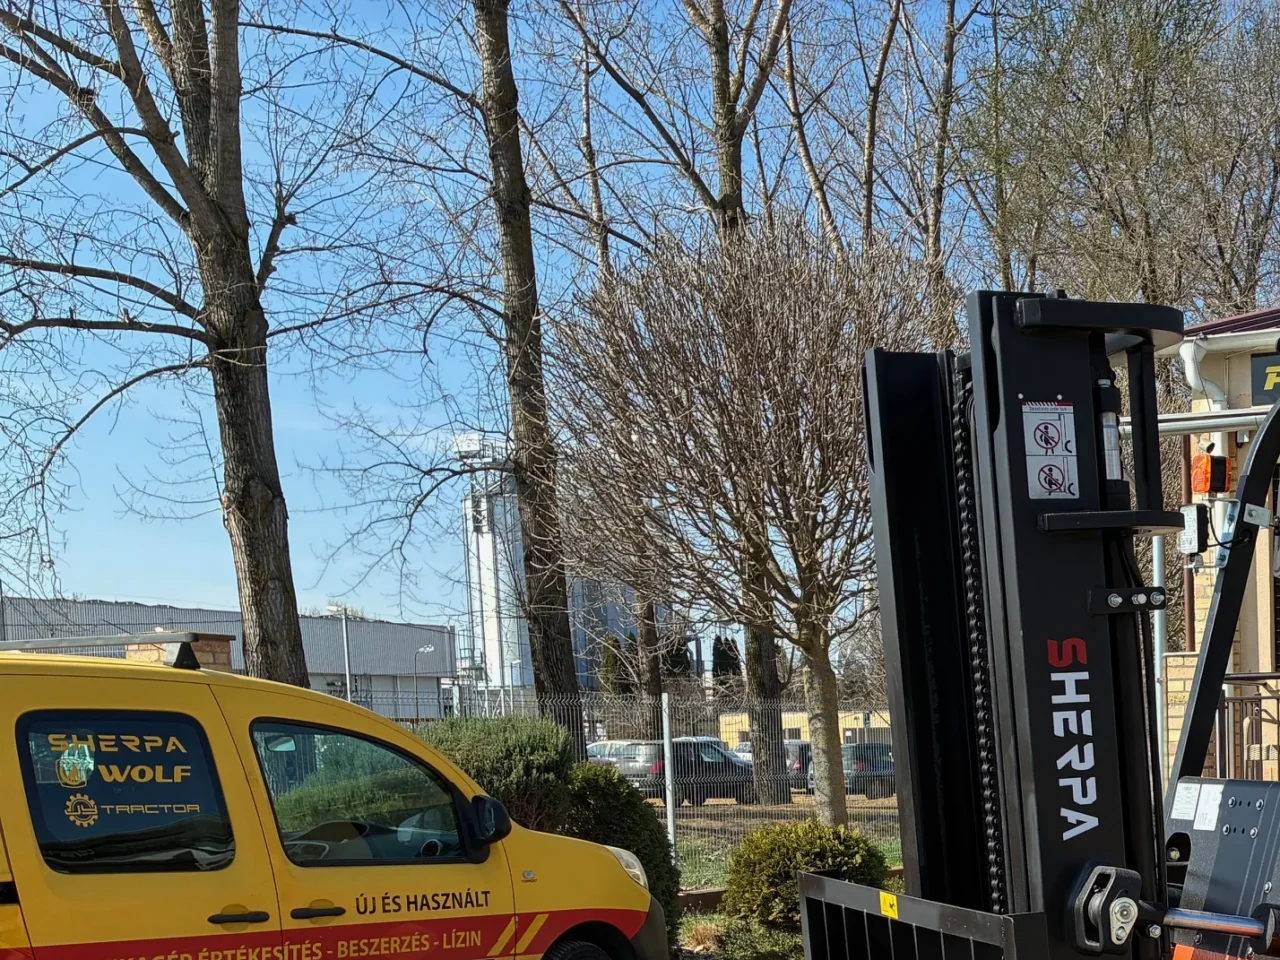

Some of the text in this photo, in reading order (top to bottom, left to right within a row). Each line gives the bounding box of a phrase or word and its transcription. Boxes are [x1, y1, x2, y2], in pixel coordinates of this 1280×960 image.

[47, 733, 188, 753] SHERPA
[1047, 637, 1100, 842] SHERPA
[97, 764, 192, 783] WOLF
[100, 804, 201, 814] TRACTOR
[355, 888, 491, 915] ÚJ ÉS HASZNÁLT
[337, 932, 430, 958] BESZERZÉS
[442, 929, 482, 949] LÍZIN
